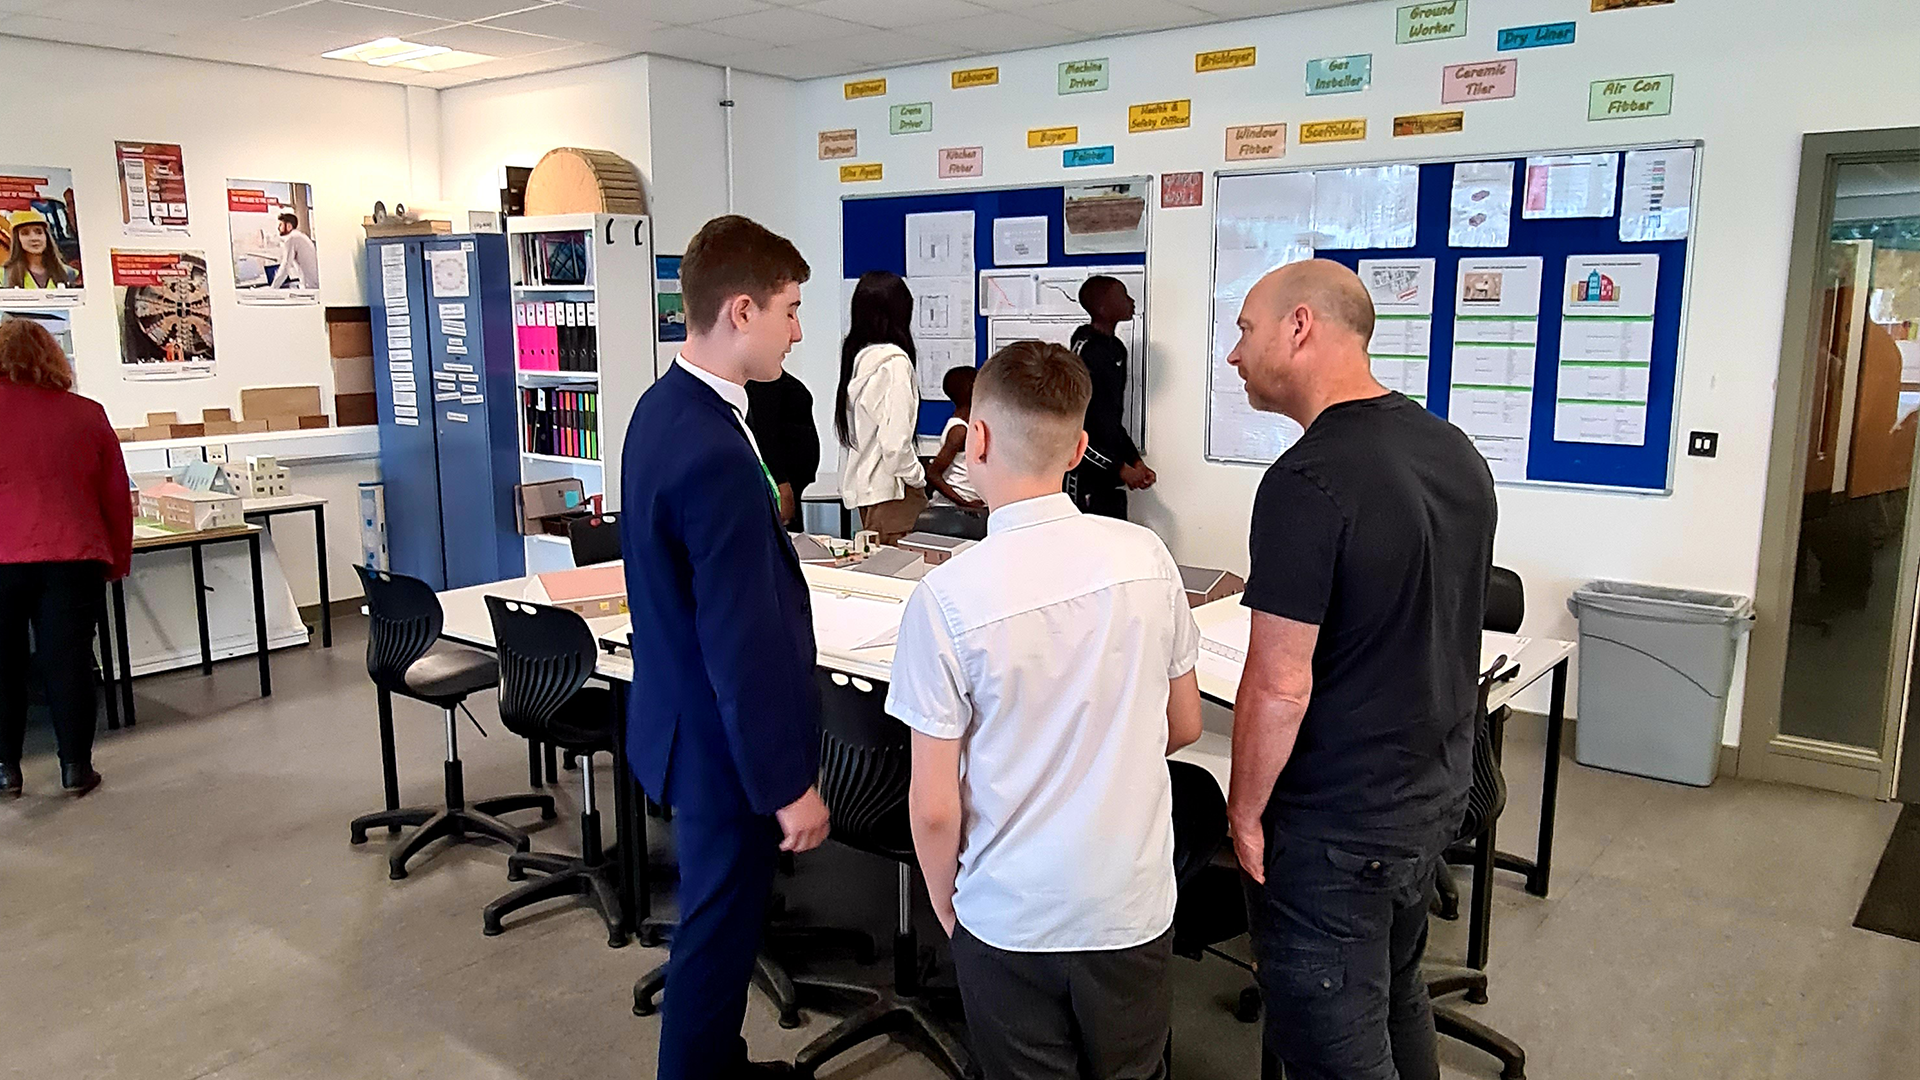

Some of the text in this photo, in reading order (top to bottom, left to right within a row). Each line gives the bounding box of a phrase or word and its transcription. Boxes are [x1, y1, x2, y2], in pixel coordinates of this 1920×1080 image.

[1410, 3, 1456, 20] Ground
[1409, 22, 1455, 38] Worker
[1503, 26, 1573, 46] Dry Liner
[1200, 51, 1252, 67] Bricklayer
[1328, 60, 1350, 72] Gas
[1065, 61, 1102, 75] Machine
[1455, 63, 1507, 80] Ceramic
[957, 70, 995, 84] Labourer
[1069, 78, 1099, 89] Driver
[1315, 75, 1363, 90] Installer
[1465, 82, 1496, 96] Tiler
[1603, 80, 1661, 96] Air Con
[900, 106, 922, 116] Crane
[1140, 102, 1179, 115] Health &
[1608, 100, 1654, 114] Fitter
[900, 120, 923, 130] Driver
[1131, 115, 1189, 129] Safety Officer
[1040, 131, 1066, 144] Buyer
[1235, 127, 1278, 140] Window
[1304, 122, 1362, 139] Scaffolder
[946, 148, 977, 160] Kitchen
[1071, 150, 1105, 162] Painter
[1239, 144, 1273, 156] Fitter
[948, 164, 973, 174] Fitter
